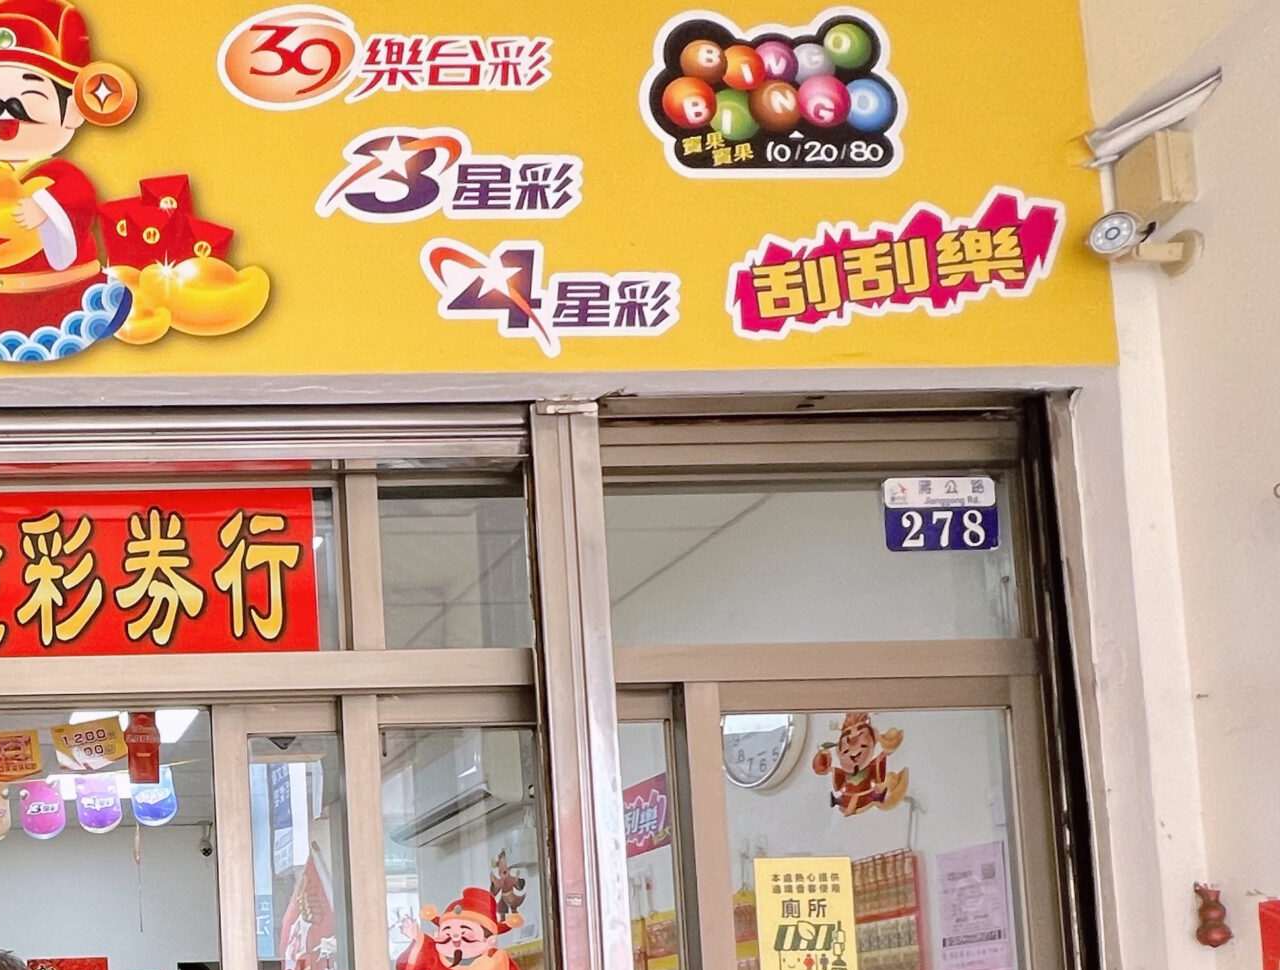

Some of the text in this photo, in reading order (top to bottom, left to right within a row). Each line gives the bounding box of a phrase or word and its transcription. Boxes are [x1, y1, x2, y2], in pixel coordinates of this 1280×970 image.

[752, 226, 1024, 318] 刮刮樂
[901, 509, 986, 547] 278
[781, 898, 827, 918] 廁所
